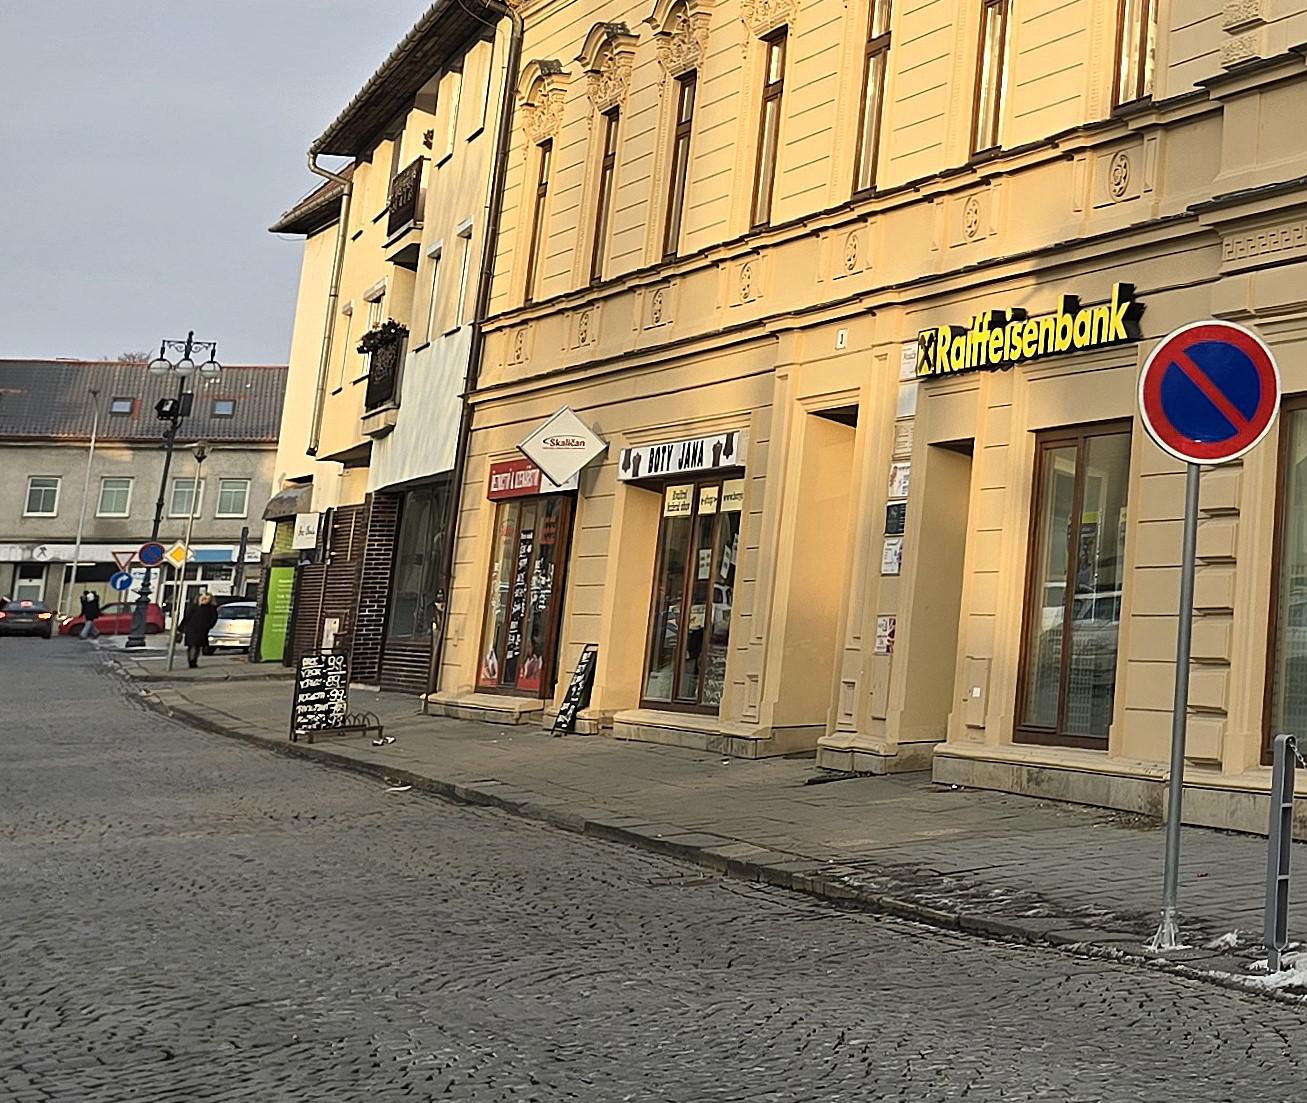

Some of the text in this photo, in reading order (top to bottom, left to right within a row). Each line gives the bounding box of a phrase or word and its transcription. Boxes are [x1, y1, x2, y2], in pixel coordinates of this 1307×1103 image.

[936, 282, 1131, 374] Raiffeisenbank
[549, 437, 585, 447] Skaličan
[648, 440, 704, 474] BOTY JANA
